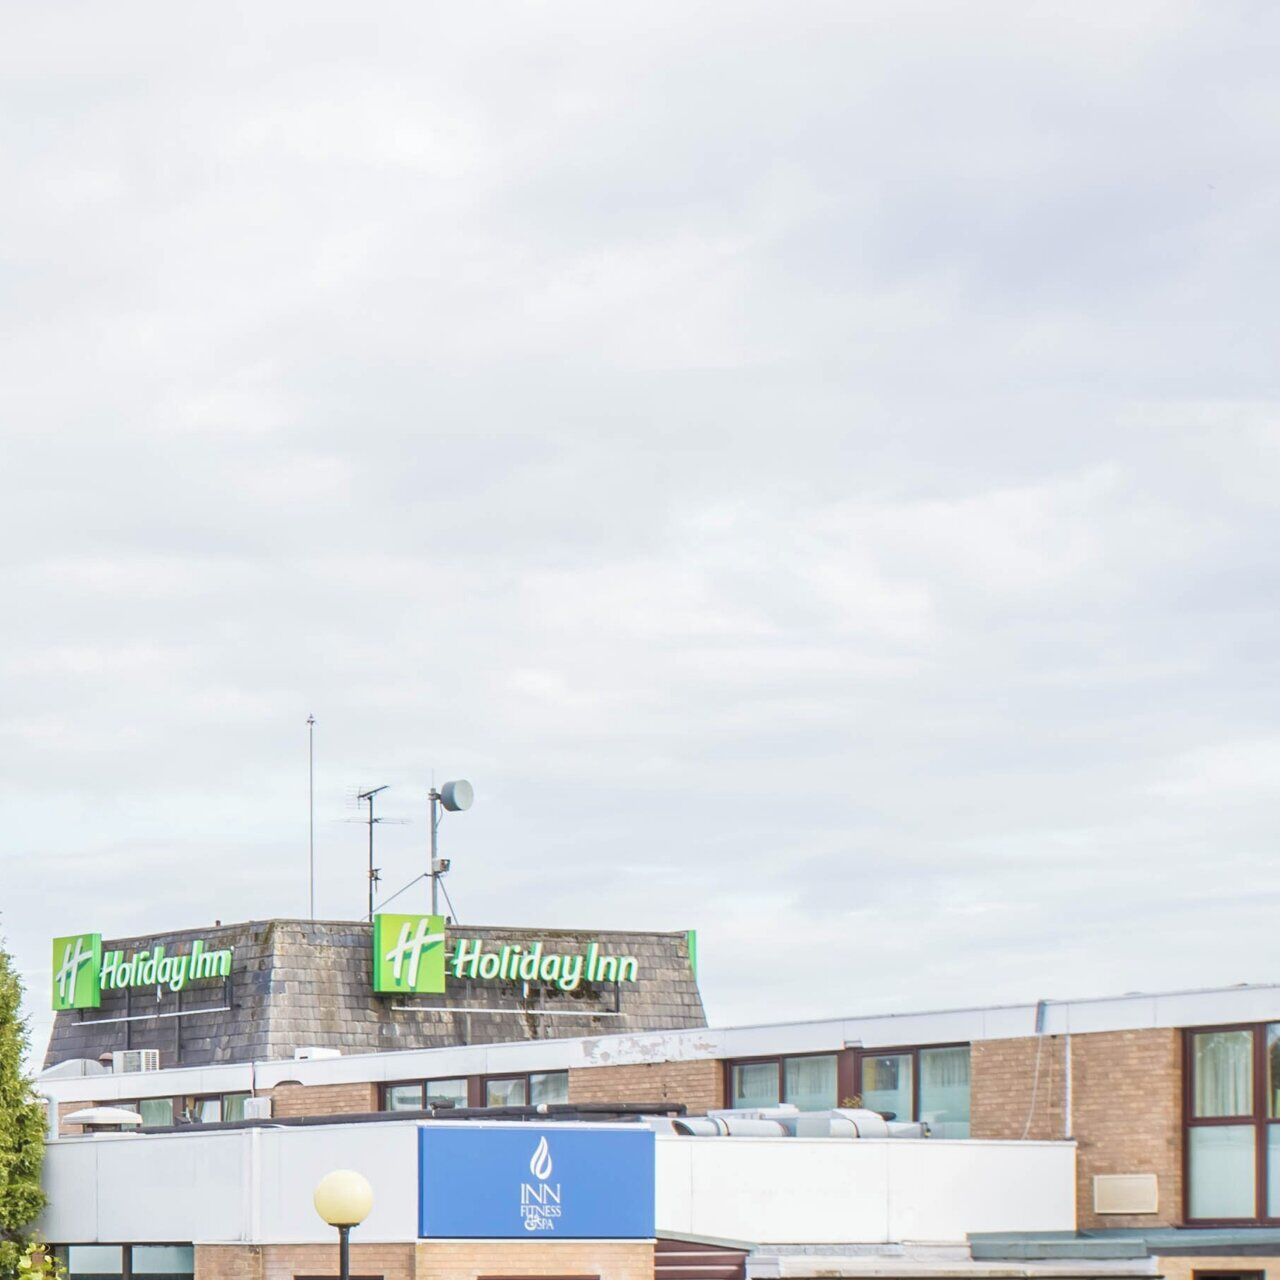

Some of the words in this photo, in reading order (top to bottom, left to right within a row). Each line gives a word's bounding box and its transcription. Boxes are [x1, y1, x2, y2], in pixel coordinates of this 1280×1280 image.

[100, 946, 189, 992] Holiday
[190, 939, 232, 980] Inn
[450, 938, 583, 991] Holiday
[585, 942, 639, 983] Inn
[520, 1205, 561, 1217] FITNESS
[521, 1183, 561, 1204] INN
